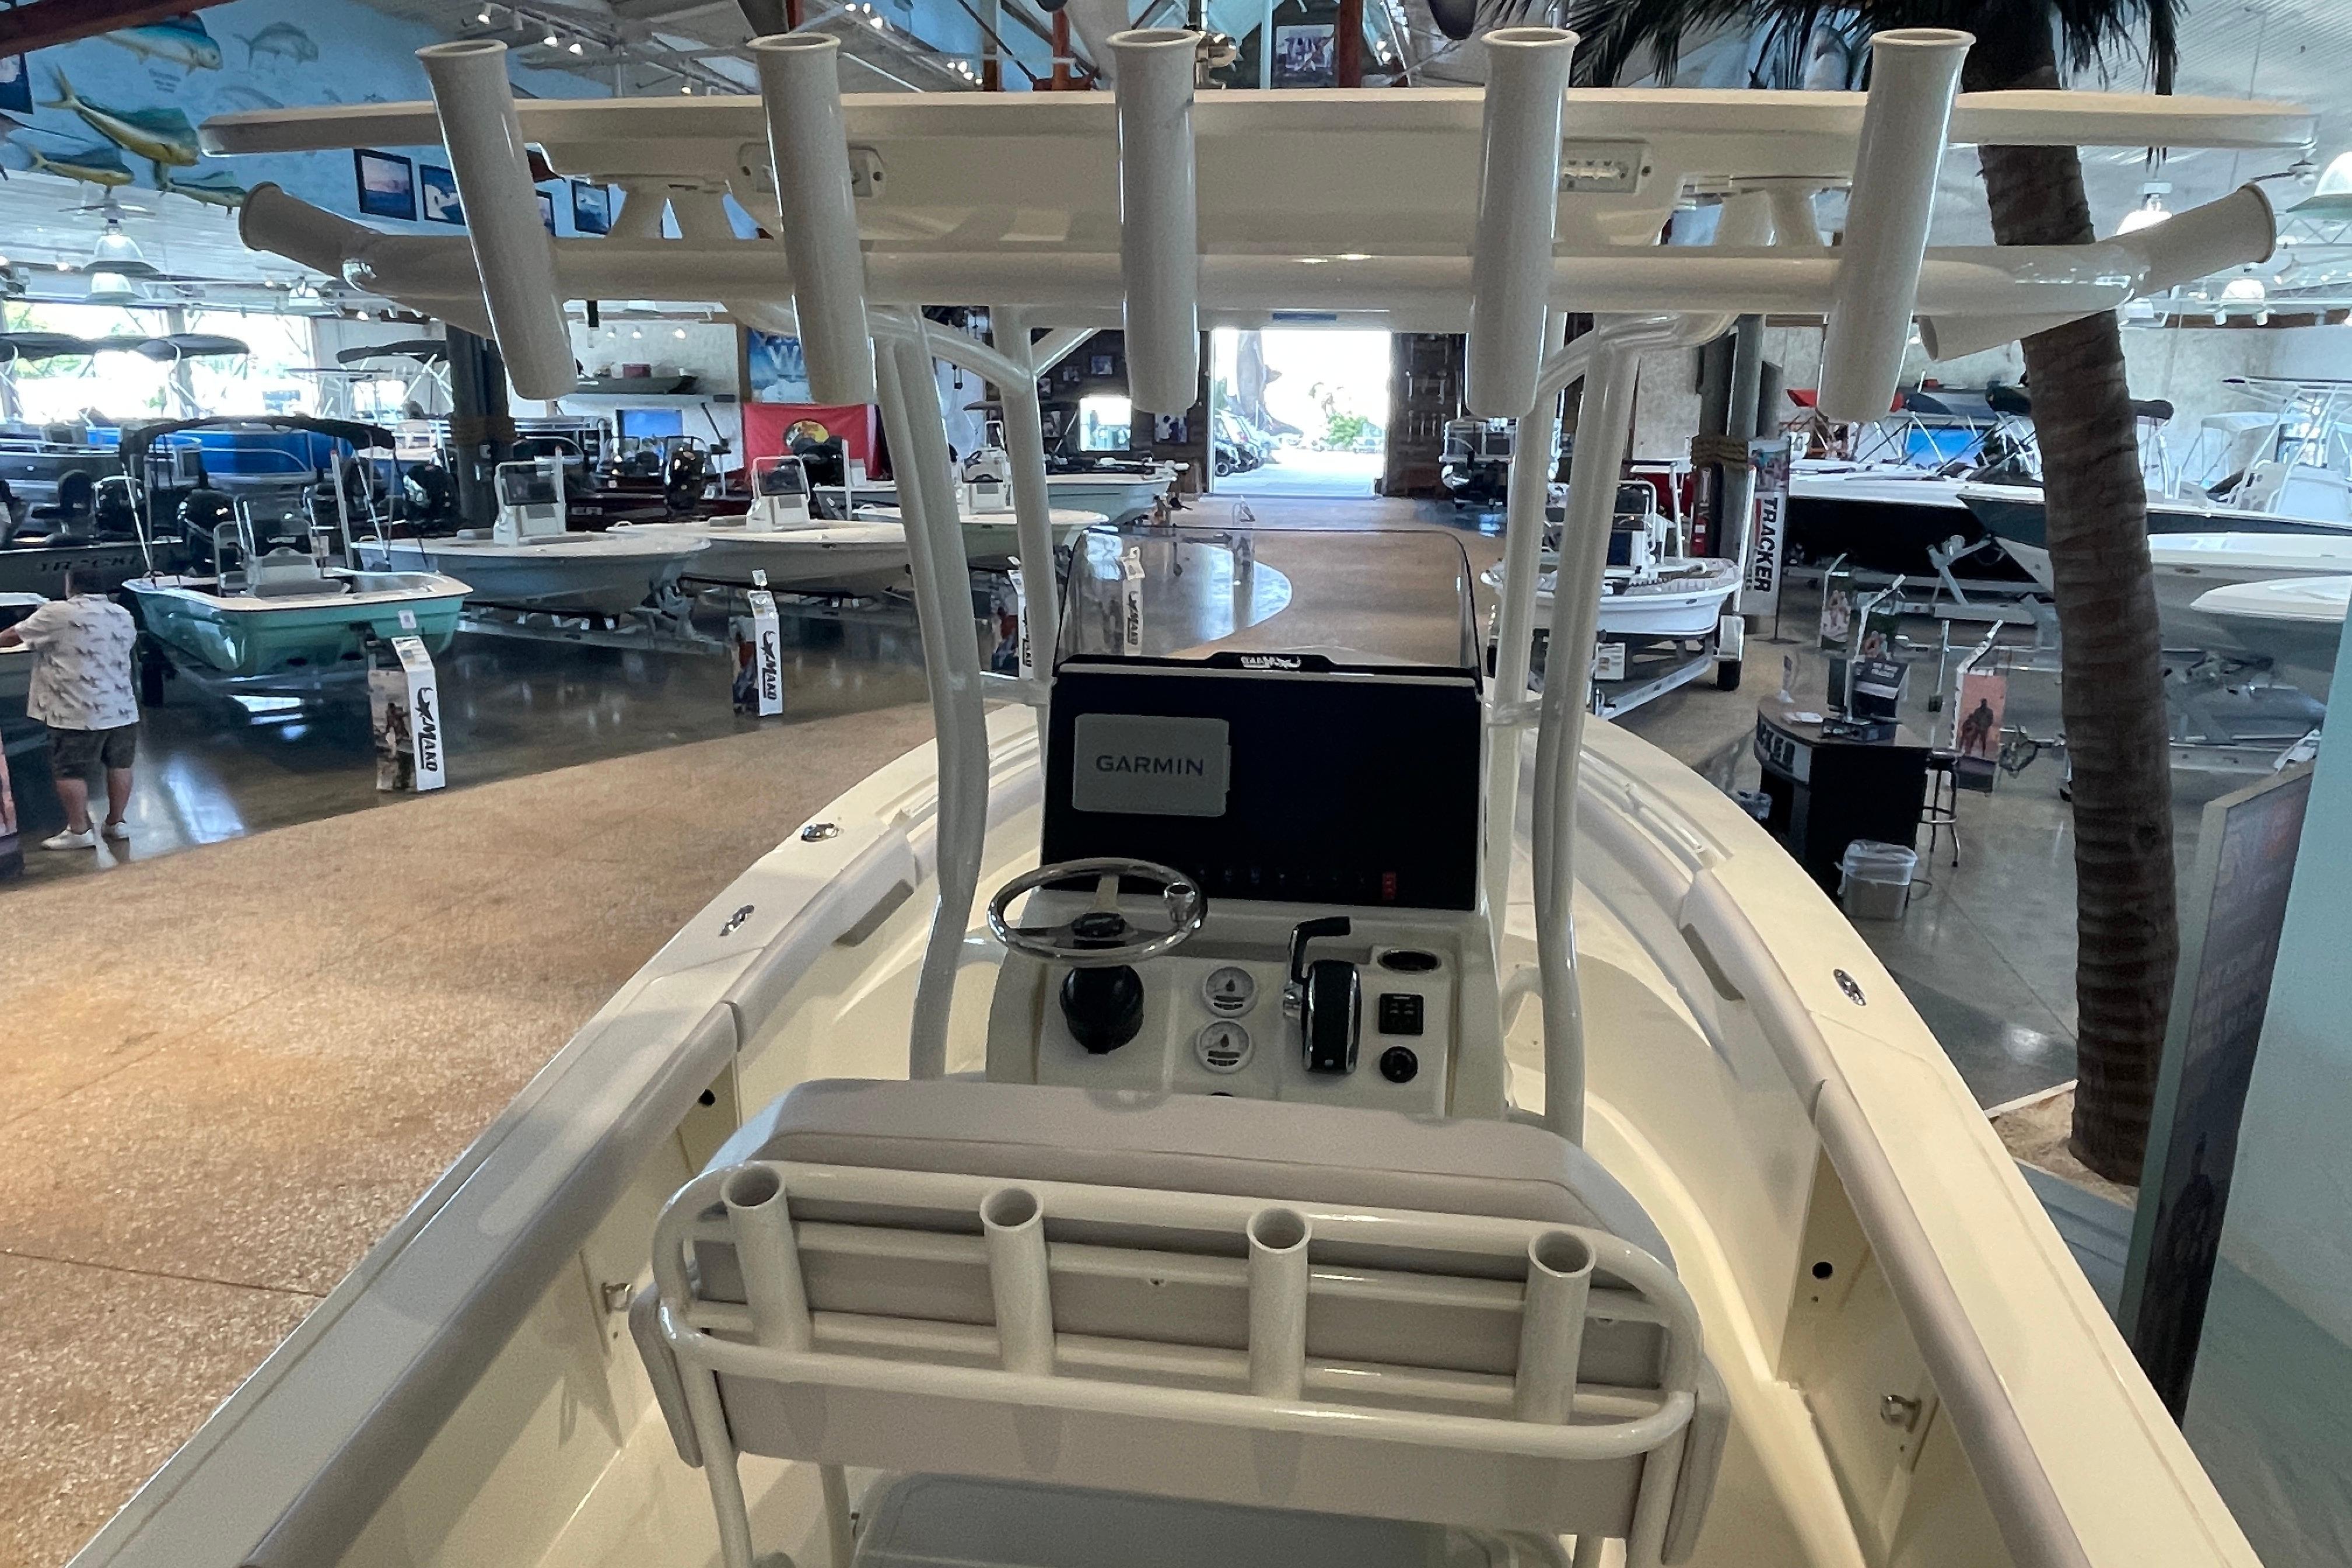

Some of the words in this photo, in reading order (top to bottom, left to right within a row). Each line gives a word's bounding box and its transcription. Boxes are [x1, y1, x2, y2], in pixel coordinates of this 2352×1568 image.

[1754, 498, 1778, 592] TRACKER
[762, 654, 777, 700] MAKO
[418, 716, 438, 772] MAKO
[1096, 755, 1204, 776] GARMIN
